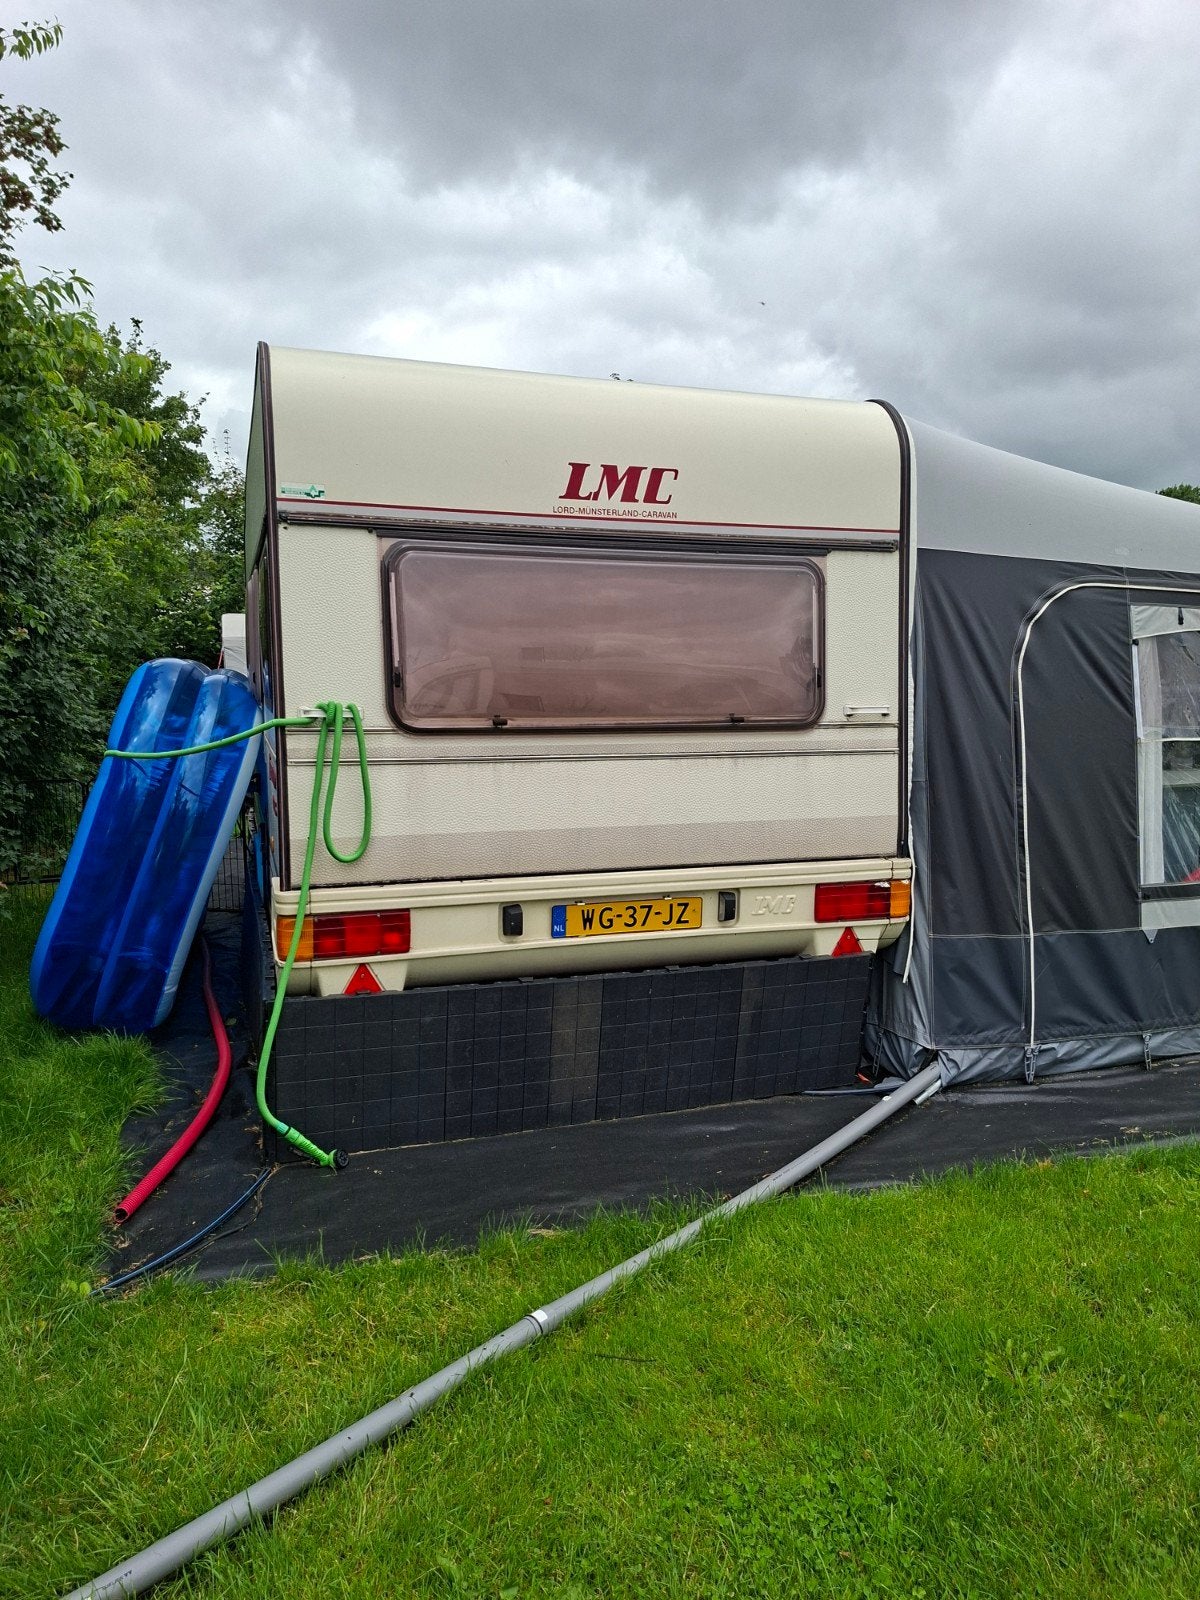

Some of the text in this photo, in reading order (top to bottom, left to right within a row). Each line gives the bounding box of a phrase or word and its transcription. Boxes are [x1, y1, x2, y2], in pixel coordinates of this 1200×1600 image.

[558, 462, 679, 505] LMC
[552, 506, 678, 519] LORD-MÜNSTERLAND-CARAVAN
[581, 902, 690, 931] WG-37-JZ
[553, 924, 565, 932] NL
